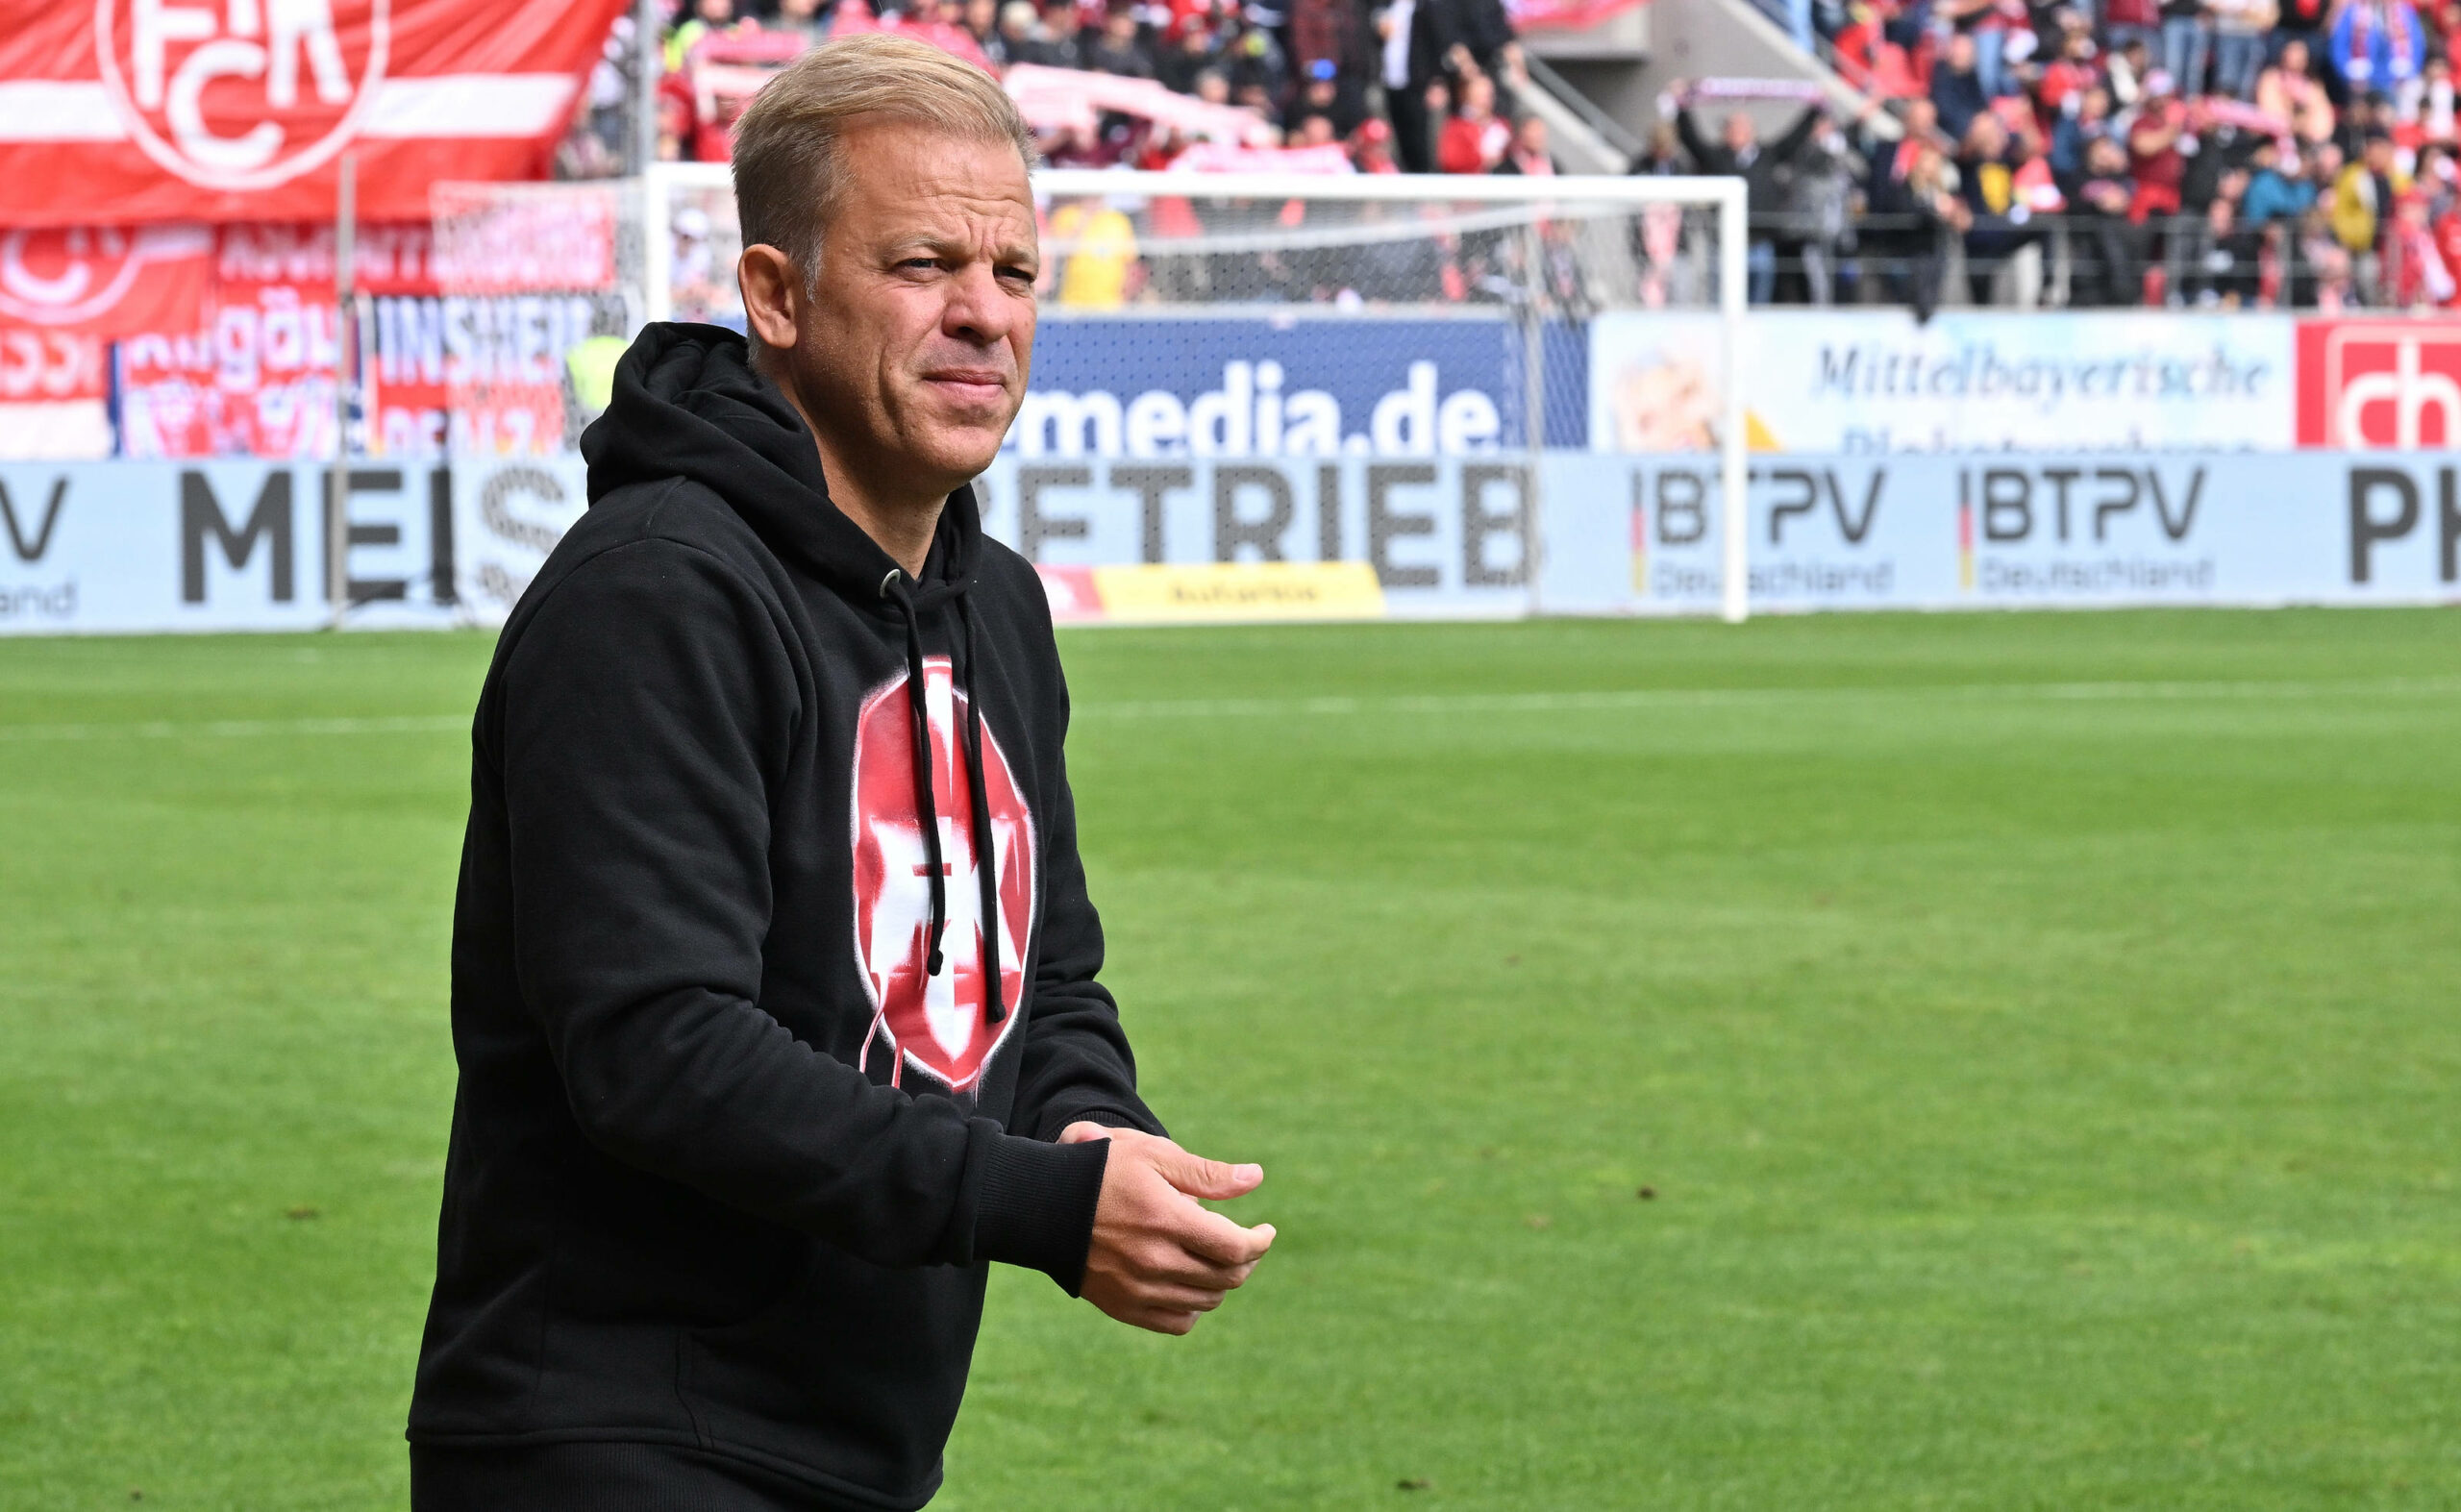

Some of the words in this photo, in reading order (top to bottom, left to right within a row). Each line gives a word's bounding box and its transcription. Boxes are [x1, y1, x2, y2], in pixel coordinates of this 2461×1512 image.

[1811, 344, 2271, 411] Mittelbayerische
[1656, 559, 1894, 595] Deuschland
[1985, 556, 2214, 592] Deutschland
